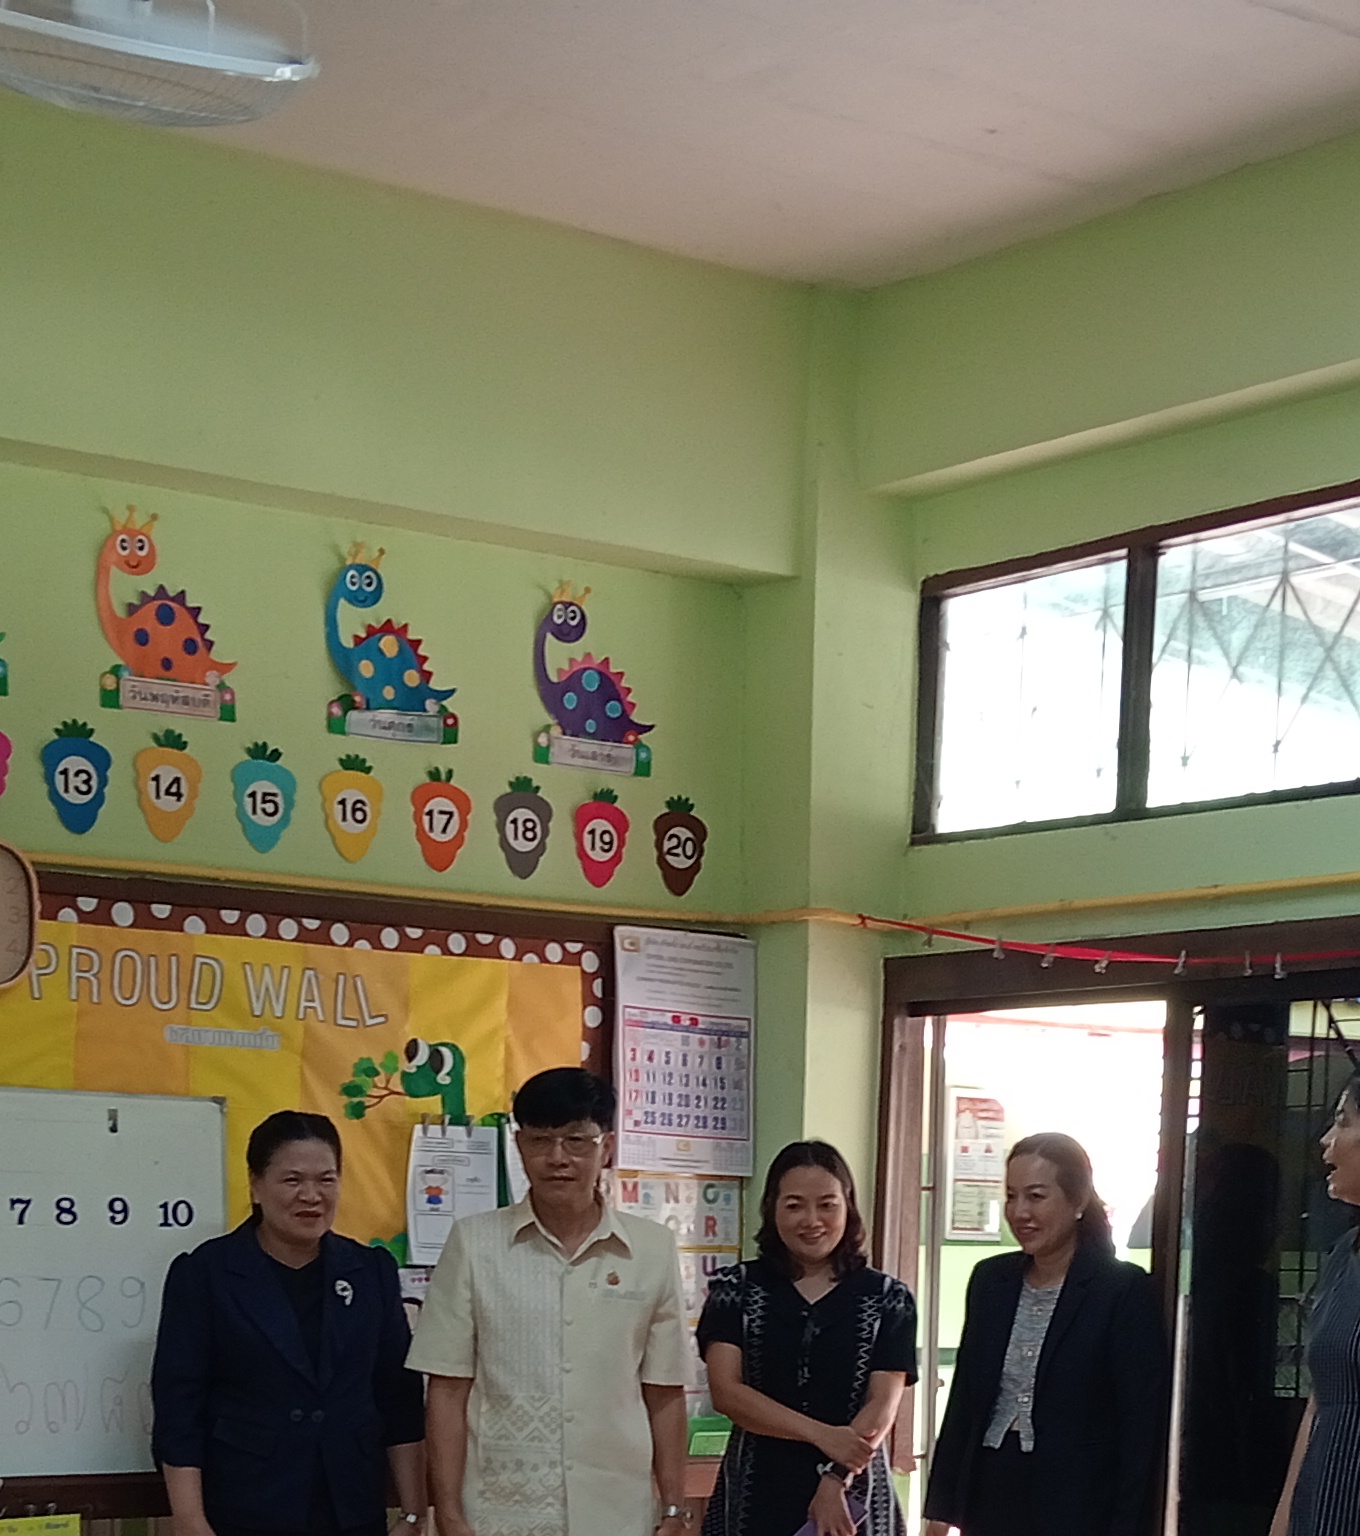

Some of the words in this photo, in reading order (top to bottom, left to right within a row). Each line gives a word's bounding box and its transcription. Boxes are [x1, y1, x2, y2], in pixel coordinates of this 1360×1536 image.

[59, 767, 92, 795] 13
[151, 774, 183, 802] 14
[247, 790, 280, 817] 15
[339, 798, 367, 825] 16
[424, 808, 454, 833] 17
[510, 818, 538, 841] 18
[587, 828, 613, 852] 19
[666, 834, 696, 859] 20
[29, 942, 224, 1012] PROUD
[244, 961, 390, 1029] WALL
[630, 1047, 637, 1062] 3
[664, 1050, 671, 1065] 5
[698, 1054, 704, 1068] 7
[646, 1070, 656, 1083] 11
[662, 1071, 673, 1086] 12
[695, 1075, 707, 1088] 14
[714, 1076, 726, 1091] 15
[629, 1089, 640, 1102] 17
[695, 1095, 708, 1109] 21
[712, 1096, 727, 1111] 22
[677, 1113, 690, 1128] 27
[622, 1181, 639, 1203] M
[665, 1182, 679, 1205] N
[9, 1197, 33, 1226] 7
[54, 1197, 79, 1227] 8
[107, 1197, 130, 1227] 9
[157, 1200, 195, 1228] 10
[704, 1215, 719, 1238] R
[702, 1255, 717, 1276] U
[39, 1278, 63, 1328] 7
[75, 1275, 106, 1332] 8
[120, 1277, 146, 1328] 9
